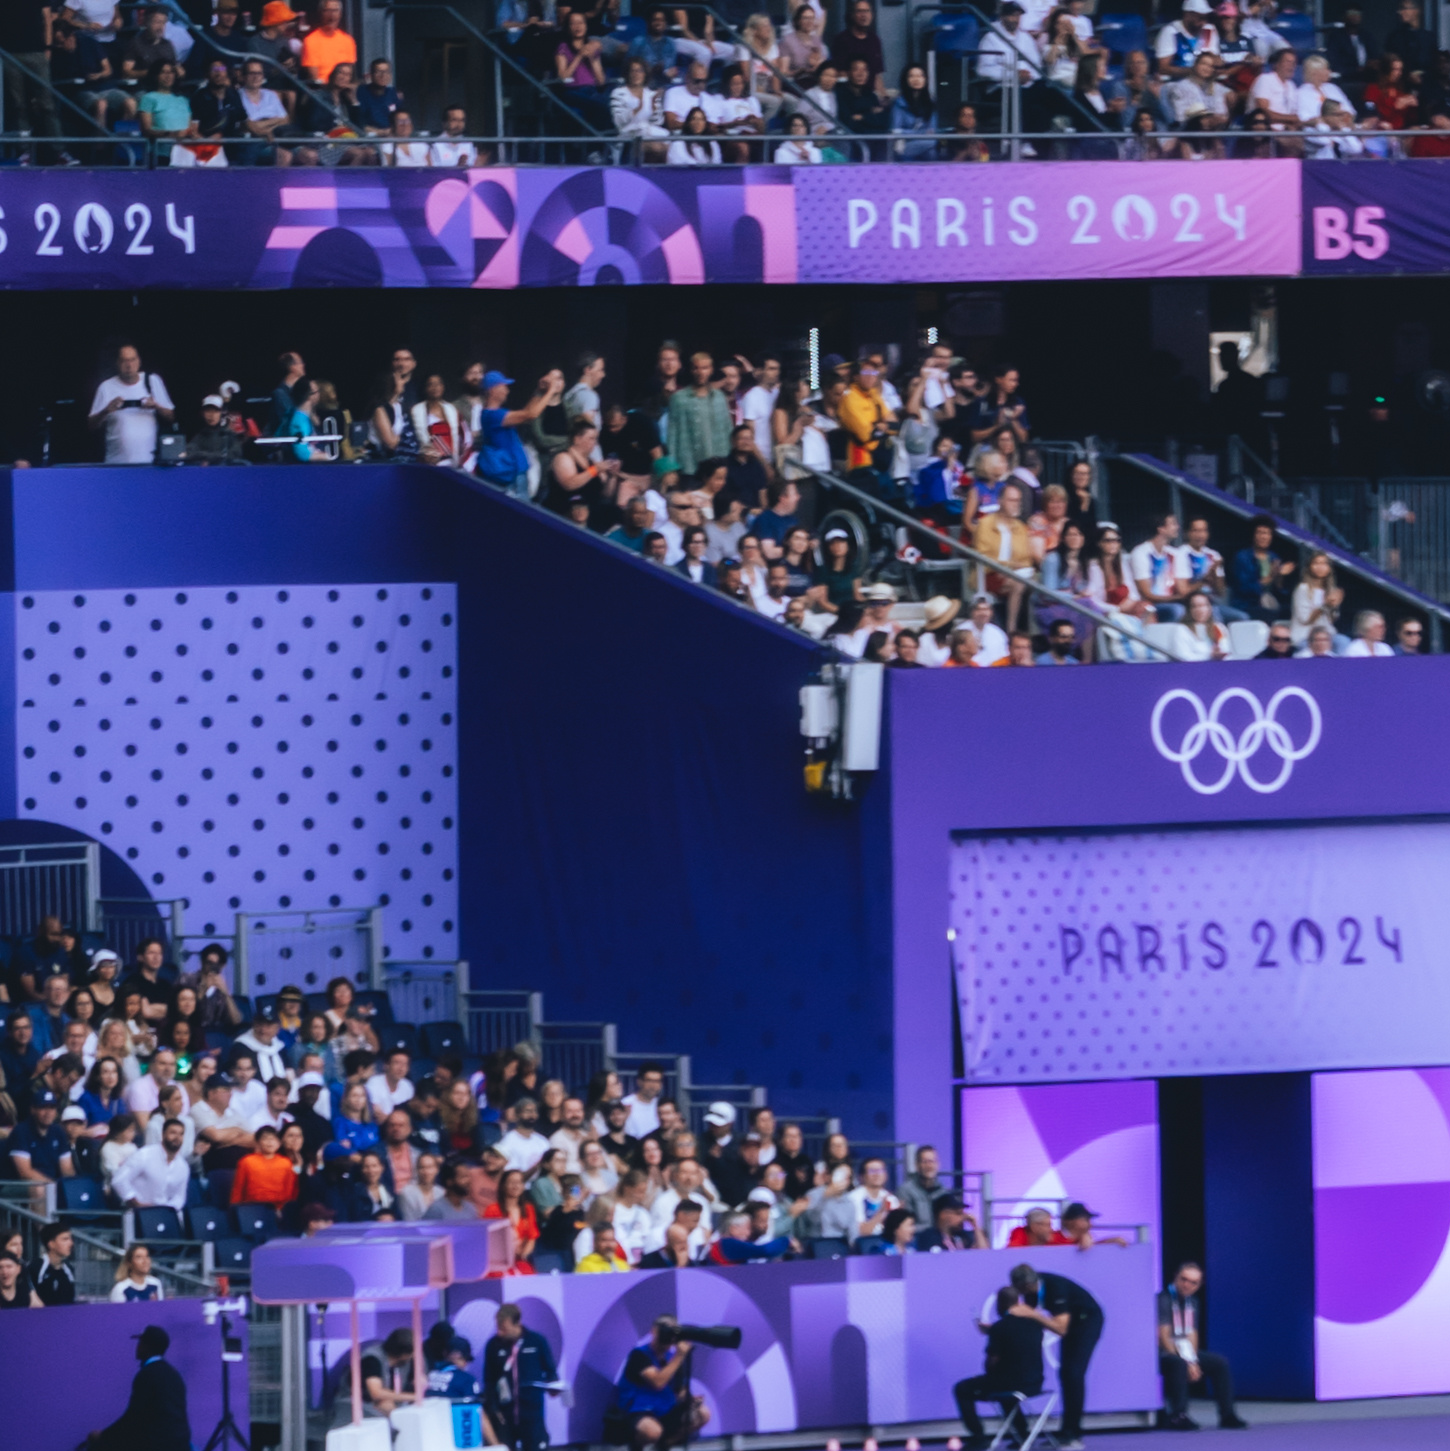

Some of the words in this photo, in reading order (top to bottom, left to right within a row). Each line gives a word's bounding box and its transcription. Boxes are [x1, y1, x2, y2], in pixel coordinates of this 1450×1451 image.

[34, 202, 196, 256] 2024
[1067, 193, 1247, 245] 2024
[1313, 206, 1390, 261] B5
[1251, 915, 1404, 970] 2024
